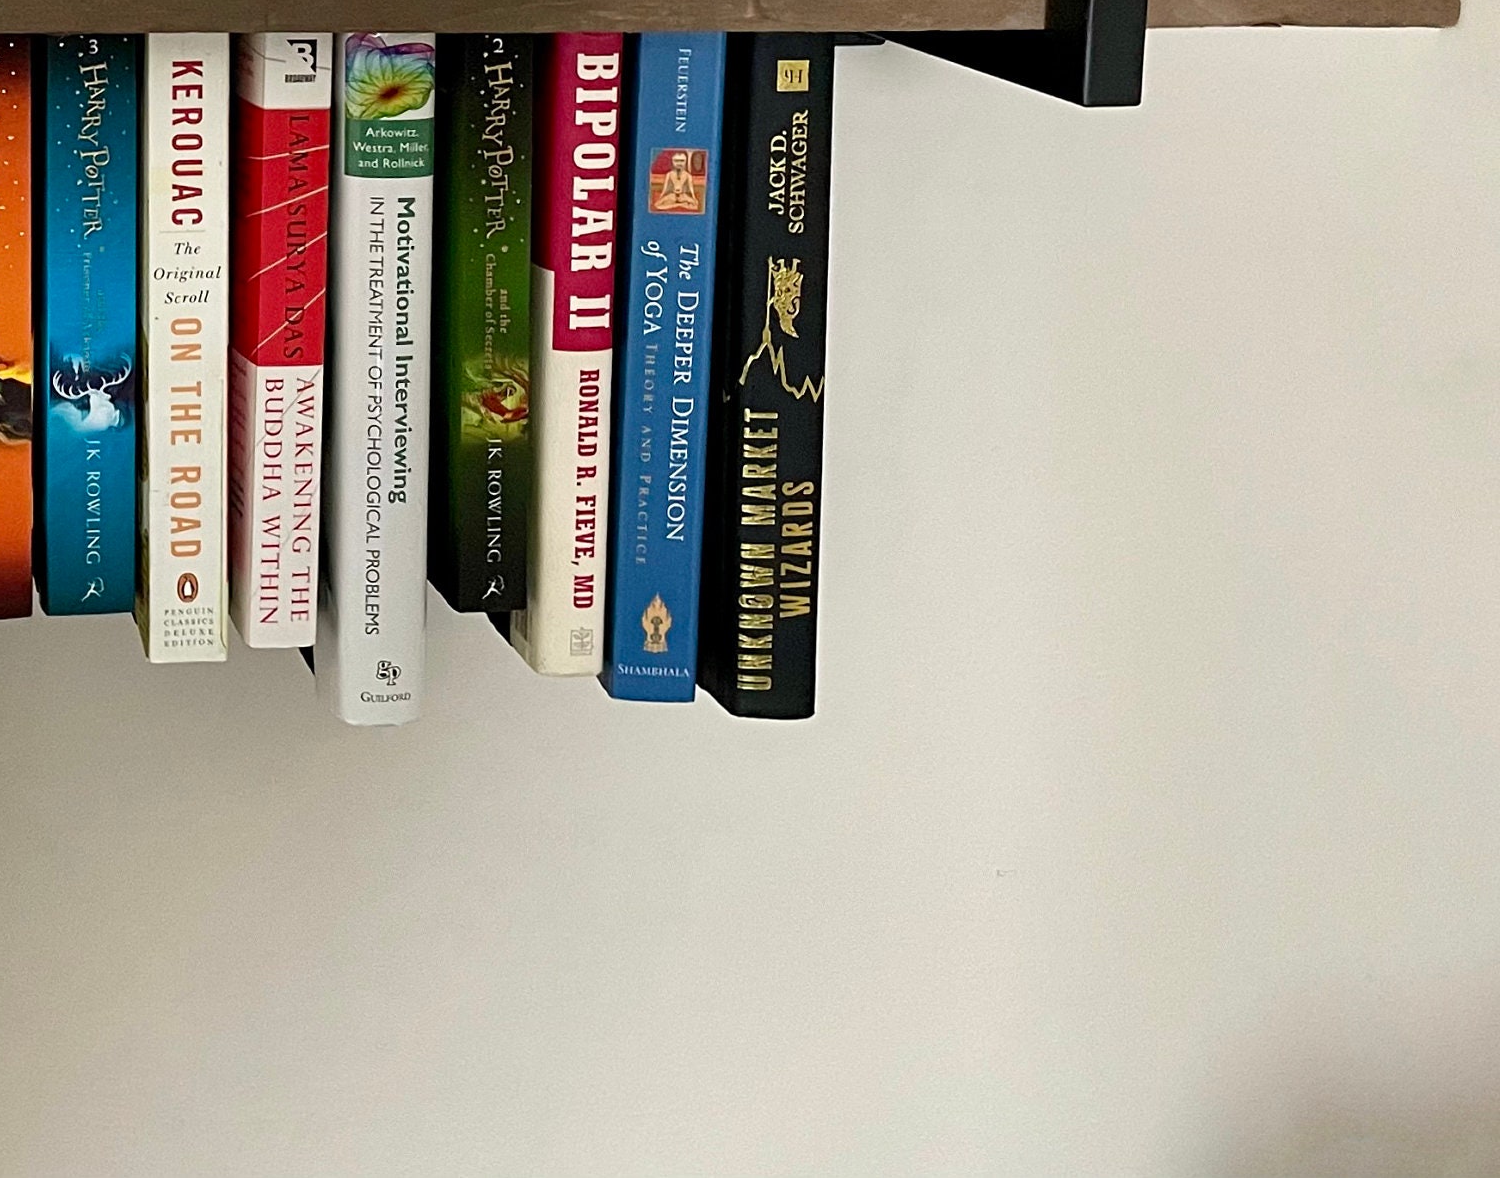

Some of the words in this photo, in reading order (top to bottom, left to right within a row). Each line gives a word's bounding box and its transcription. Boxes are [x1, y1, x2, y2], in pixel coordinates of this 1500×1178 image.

[88, 38, 99, 55] 3
[492, 38, 504, 54] 2
[77, 61, 110, 147] HARRY
[481, 61, 514, 147] HARRY
[674, 48, 692, 133] FEUERSTEIN
[171, 60, 204, 226] KEROUAC
[288, 114, 310, 193] LAMA
[358, 158, 379, 169] and
[383, 157, 426, 169] Rollnick
[570, 52, 620, 272] BIPOLAR
[770, 130, 787, 152] D.
[788, 110, 809, 234] SCHWAGER
[78, 145, 111, 240] POTTER
[370, 196, 385, 215] IN
[482, 145, 515, 239] POTTER
[768, 159, 786, 215] JACK
[173, 241, 202, 256] The
[285, 203, 307, 295] SURYA
[369, 217, 384, 253] THE
[641, 240, 668, 261] of
[678, 243, 700, 281] The
[152, 265, 222, 280] Original
[164, 290, 210, 304] Scroll
[395, 197, 416, 346] Motivational
[484, 253, 497, 309] Chamber
[499, 288, 511, 311] and
[643, 266, 668, 336] YOGA
[170, 317, 202, 362] ON
[282, 306, 304, 359] DAS
[368, 260, 384, 359] TREATMENT
[484, 311, 496, 325] of
[499, 314, 511, 334] the
[569, 294, 611, 330] II
[672, 291, 700, 385] DEEPER
[367, 365, 382, 390] OF
[483, 326, 496, 371] Secrets
[642, 343, 659, 414] THEORY
[170, 380, 202, 446] THE
[262, 378, 285, 502] BUDDHA
[388, 355, 414, 504] Interviewing
[577, 369, 600, 457] RONALD
[640, 425, 653, 463] AND
[291, 377, 315, 554] AWAKENING
[365, 395, 382, 544] PSYCHOLOGICAL
[575, 466, 597, 487] R.
[665, 397, 695, 542] DIMENSION
[740, 408, 779, 526] MARKET
[85, 471, 101, 565] ROWLING
[169, 465, 202, 558] ROAD
[486, 470, 502, 564] ROWLING
[571, 495, 597, 567] FIEVE,
[634, 474, 652, 565] PRACTICE
[259, 515, 281, 625] WITHIN
[779, 481, 815, 619] WIZARDS
[163, 618, 214, 627] CLASSICS
[164, 607, 214, 616] PENGUIN
[290, 567, 310, 623] THE
[365, 549, 380, 636] PROBLEMS
[572, 574, 594, 610] MD
[736, 543, 775, 691] UNKNOWN
[164, 629, 214, 637] DELUXE
[164, 639, 214, 647] EDITION
[617, 663, 690, 678] SHAMBHALA
